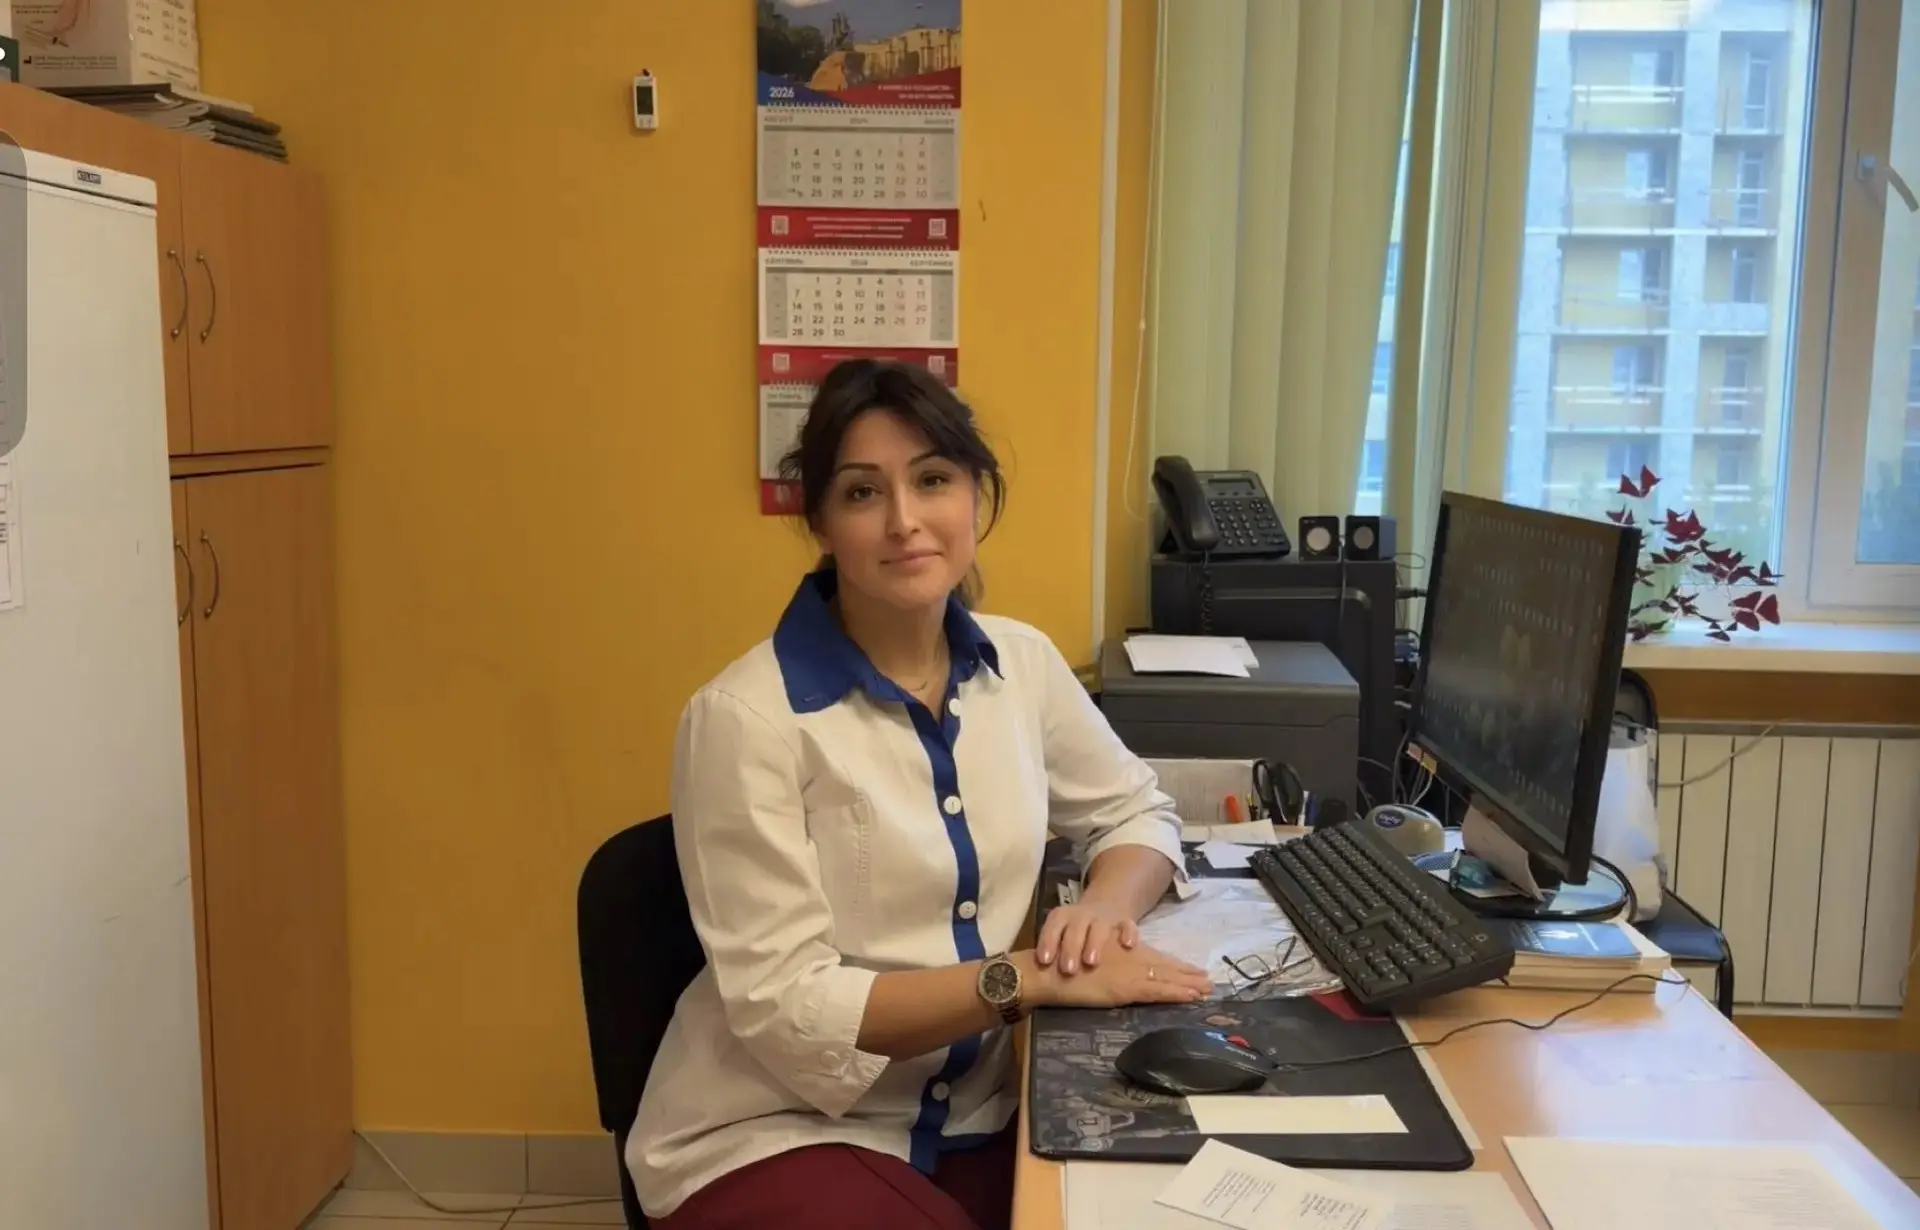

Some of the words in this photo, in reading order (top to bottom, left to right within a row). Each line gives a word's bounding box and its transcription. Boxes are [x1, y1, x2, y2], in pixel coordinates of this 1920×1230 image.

[769, 86, 795, 99] 2026
[790, 161, 802, 171] 10
[873, 163, 885, 172] 14
[851, 176, 866, 186] 20
[853, 289, 866, 299] 10
[811, 314, 824, 325] 22
[852, 315, 866, 325] 24
[811, 327, 825, 337] 29
